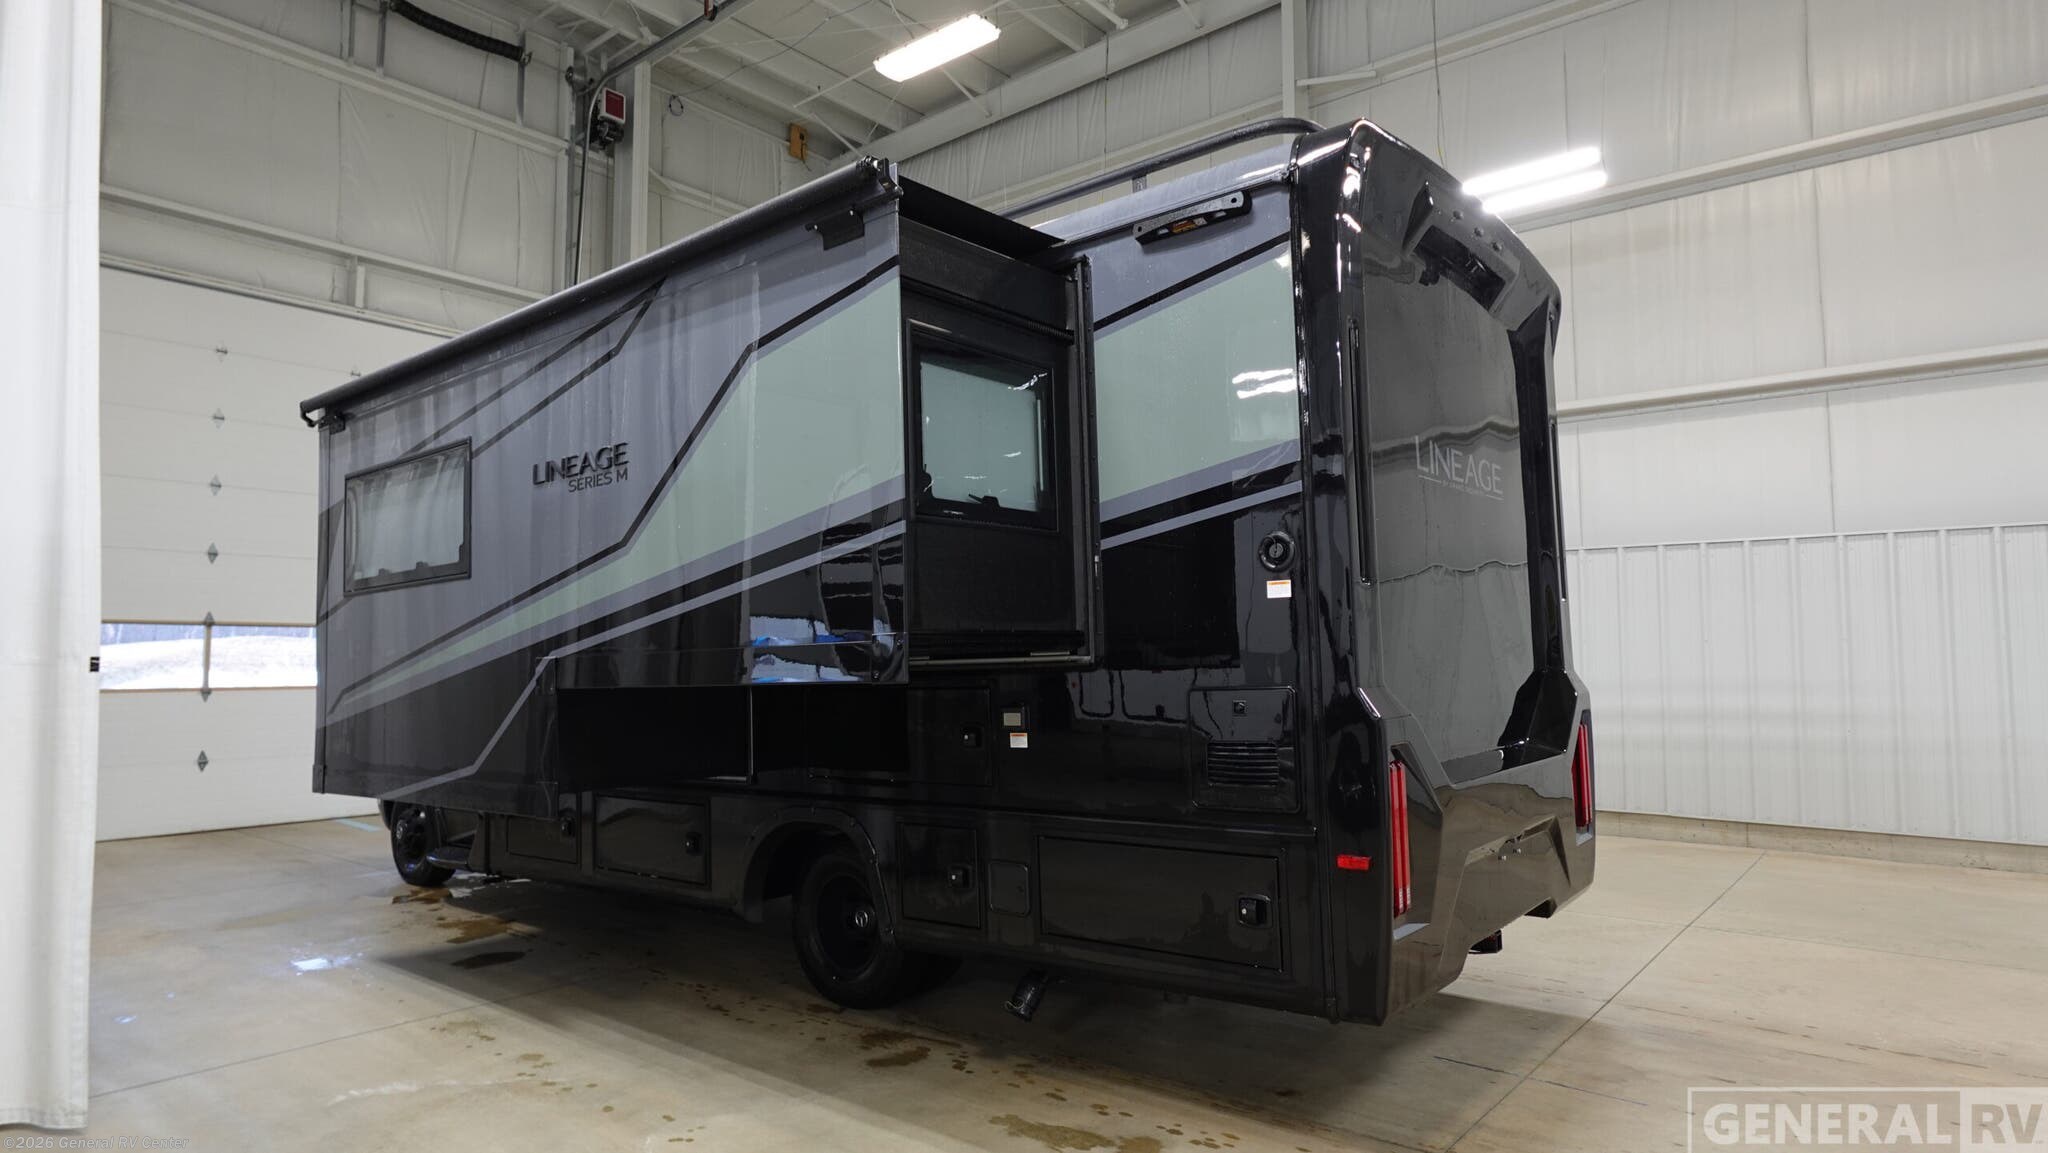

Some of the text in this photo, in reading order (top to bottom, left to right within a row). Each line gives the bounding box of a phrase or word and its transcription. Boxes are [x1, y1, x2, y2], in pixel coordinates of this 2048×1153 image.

[532, 442, 629, 485] LINEAGE
[568, 467, 628, 493] SERIES M
[1415, 435, 1504, 494] LINEAGE
